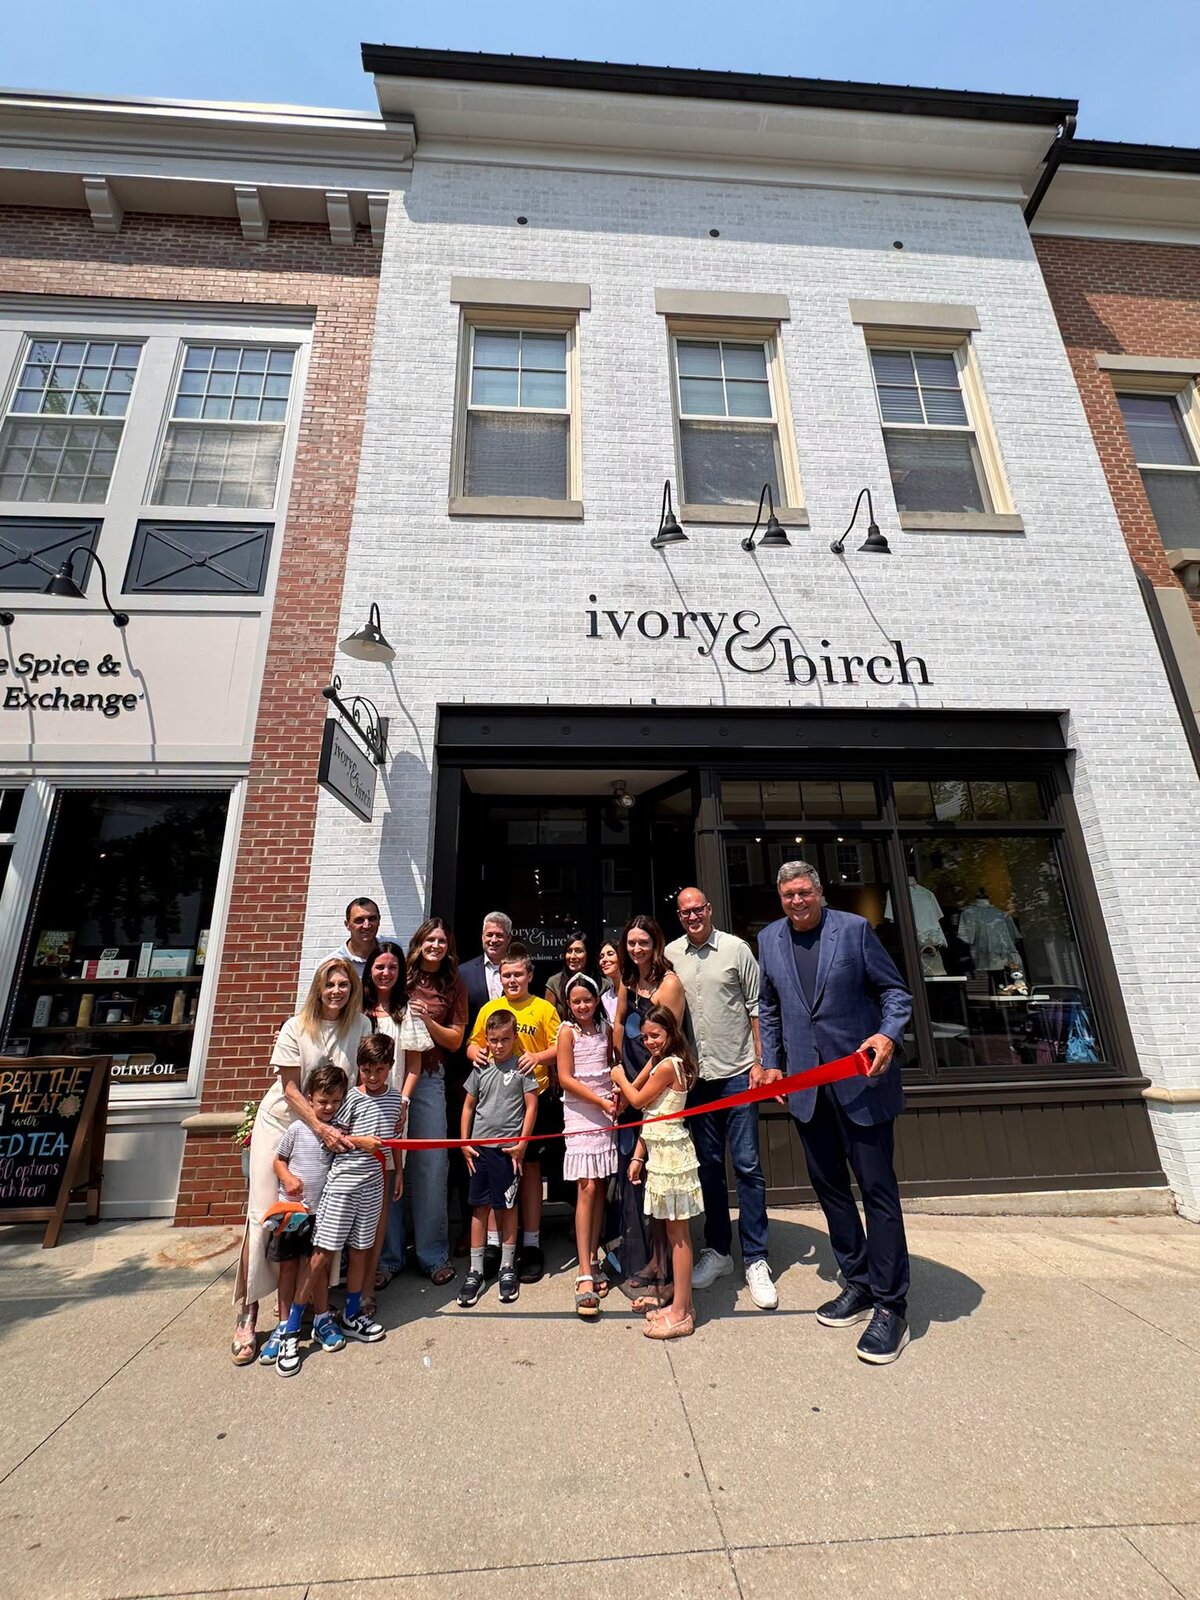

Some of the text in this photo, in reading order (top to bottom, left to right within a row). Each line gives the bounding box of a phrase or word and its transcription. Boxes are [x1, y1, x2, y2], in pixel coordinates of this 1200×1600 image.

[15, 653, 90, 683] Spice
[97, 654, 121, 676] &
[3, 686, 138, 717] Exchange
[111, 1063, 176, 1076] OLIVE OIL
[0, 1068, 92, 1095] BEAT THE
[11, 1093, 62, 1113] HEAT
[27, 1132, 69, 1157] TEA
[15, 1159, 60, 1180] options
[19, 1177, 46, 1198] from
